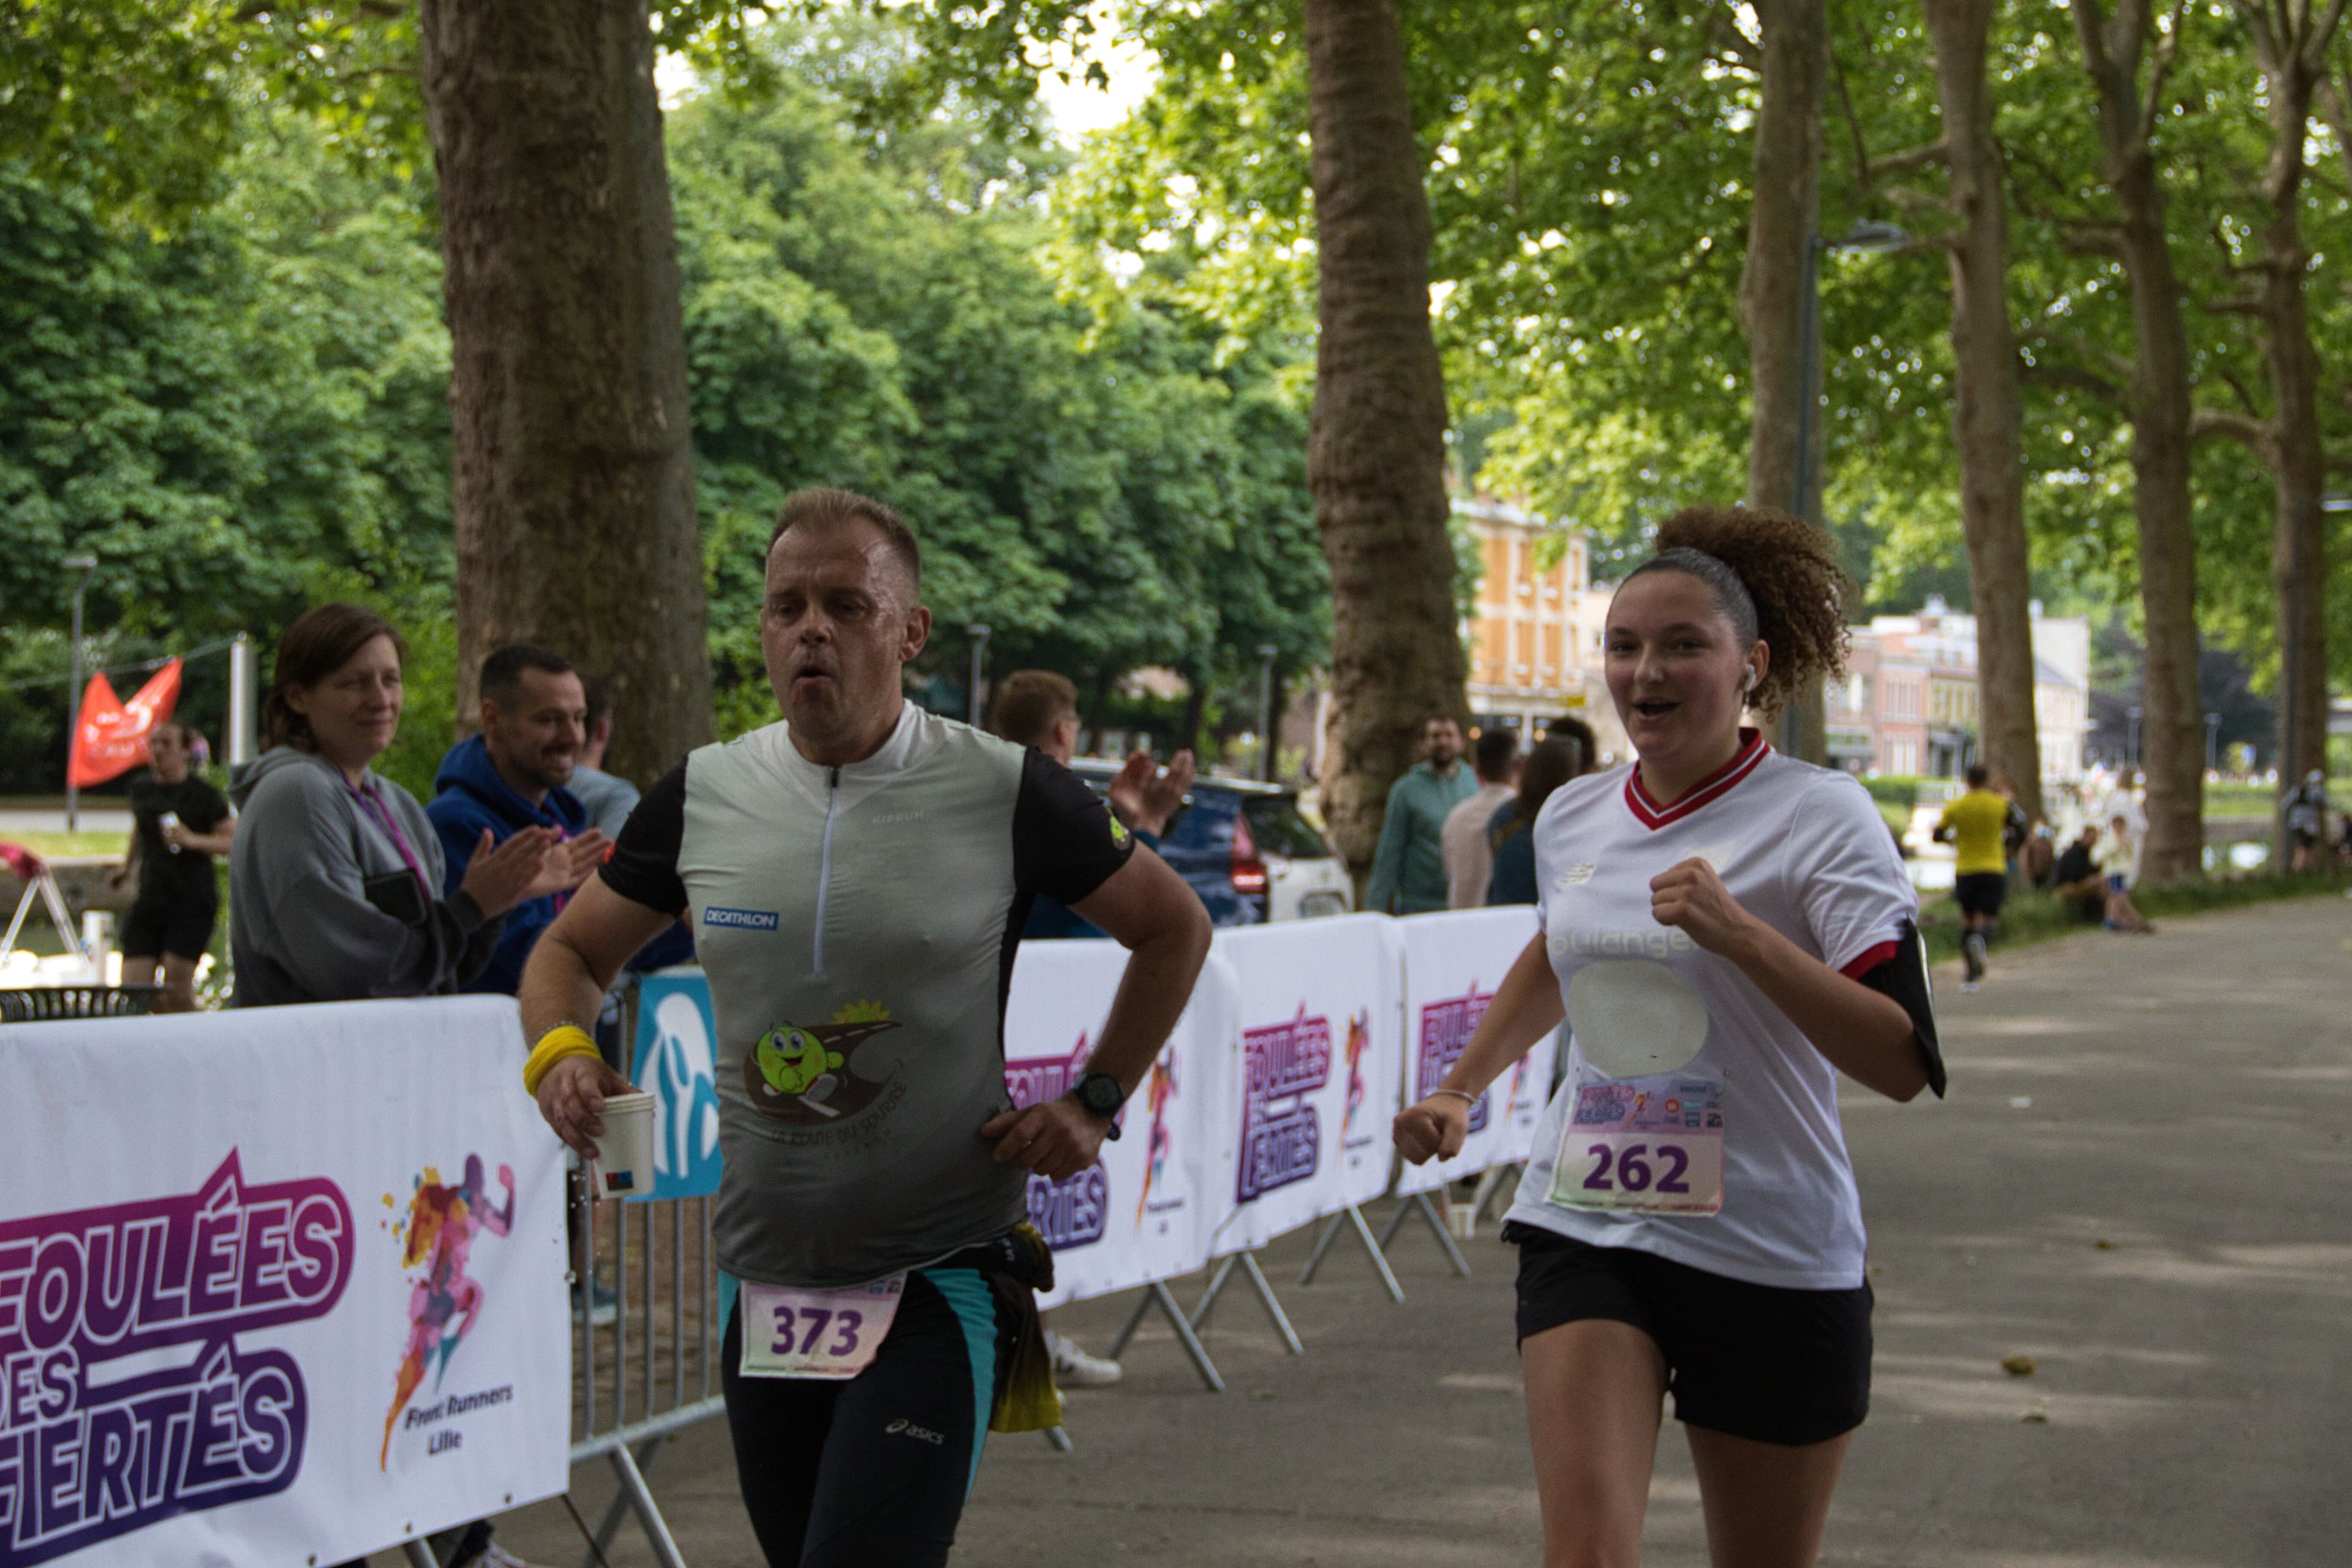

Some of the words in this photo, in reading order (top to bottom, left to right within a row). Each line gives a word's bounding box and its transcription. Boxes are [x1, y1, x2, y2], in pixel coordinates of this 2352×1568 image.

[707, 910, 775, 926] DECATHLON
[1583, 1143, 1690, 1194] 262
[771, 1305, 863, 1356] 373
[0, 1344, 80, 1432] ES
[404, 1401, 444, 1431] Front
[446, 1384, 513, 1416] Runners
[428, 1430, 462, 1456] Lille
